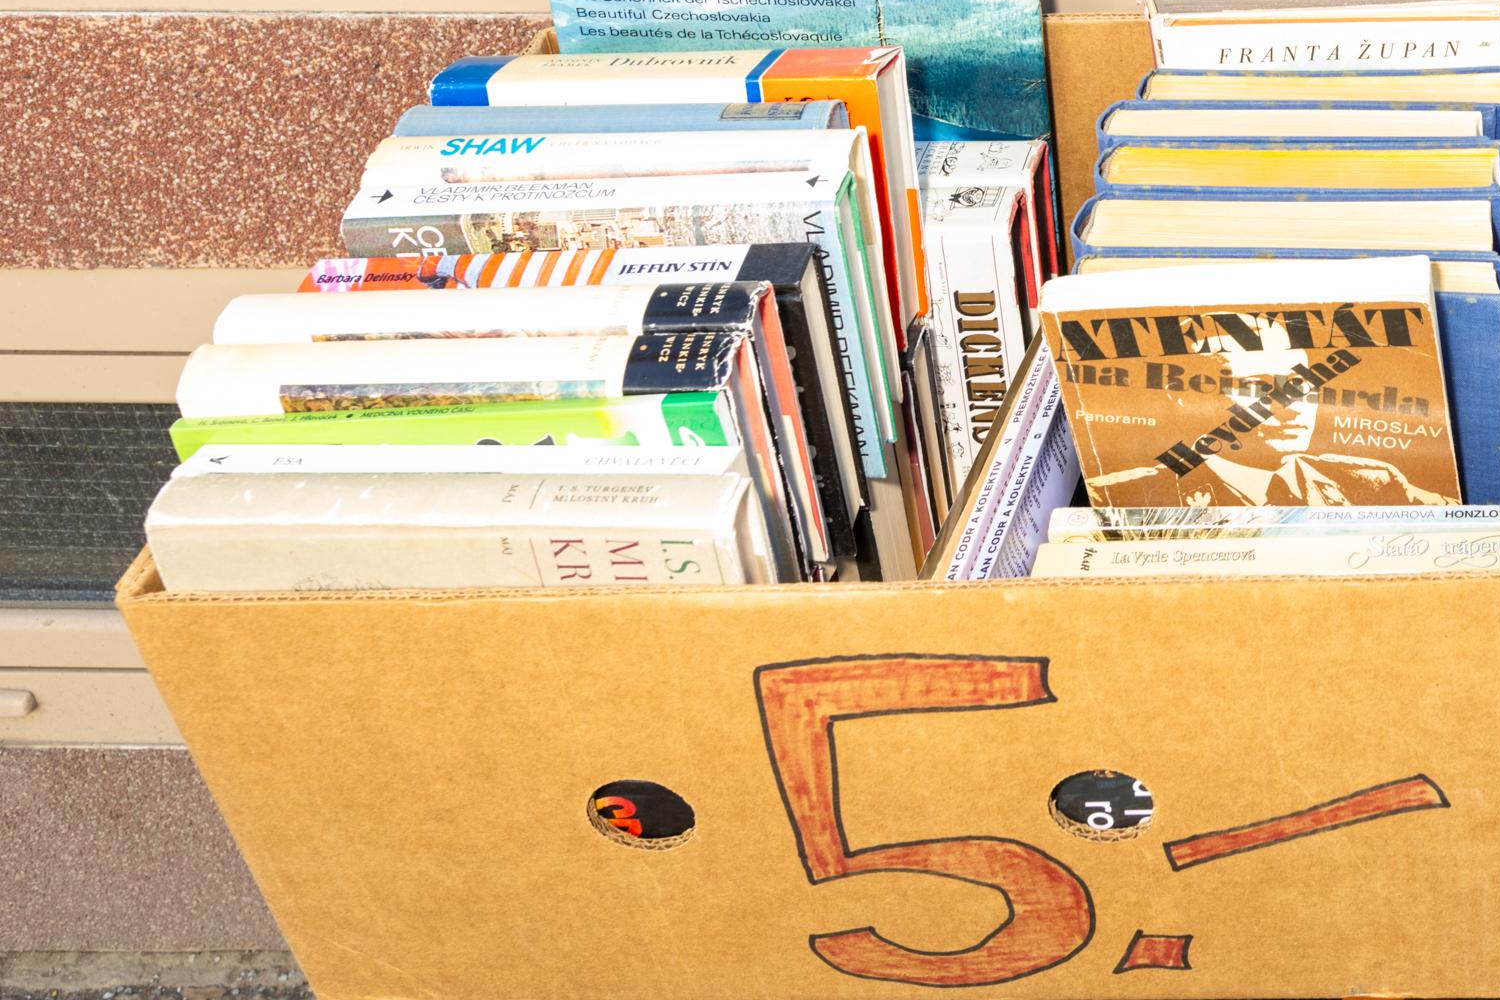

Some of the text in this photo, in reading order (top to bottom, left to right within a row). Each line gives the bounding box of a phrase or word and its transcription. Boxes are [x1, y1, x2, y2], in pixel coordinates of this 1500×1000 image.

[575, 6, 772, 25] Beautiful Czechoslovakia
[579, 25, 843, 45] Les beautés de la Tchécoslovaquie
[608, 53, 739, 69] Dubrovnik
[1217, 37, 1462, 66] FRANTA ŽUPAN
[439, 135, 547, 157] SHAW
[315, 270, 417, 287] Barbara Delinsky
[1055, 304, 1423, 363] ATENTÁT
[1064, 362, 1131, 388] na
[1075, 410, 1158, 427] Panorama
[1153, 346, 1363, 478] Heydricha
[1333, 415, 1444, 439] MIROSLAV
[1331, 432, 1413, 451] IVANOV
